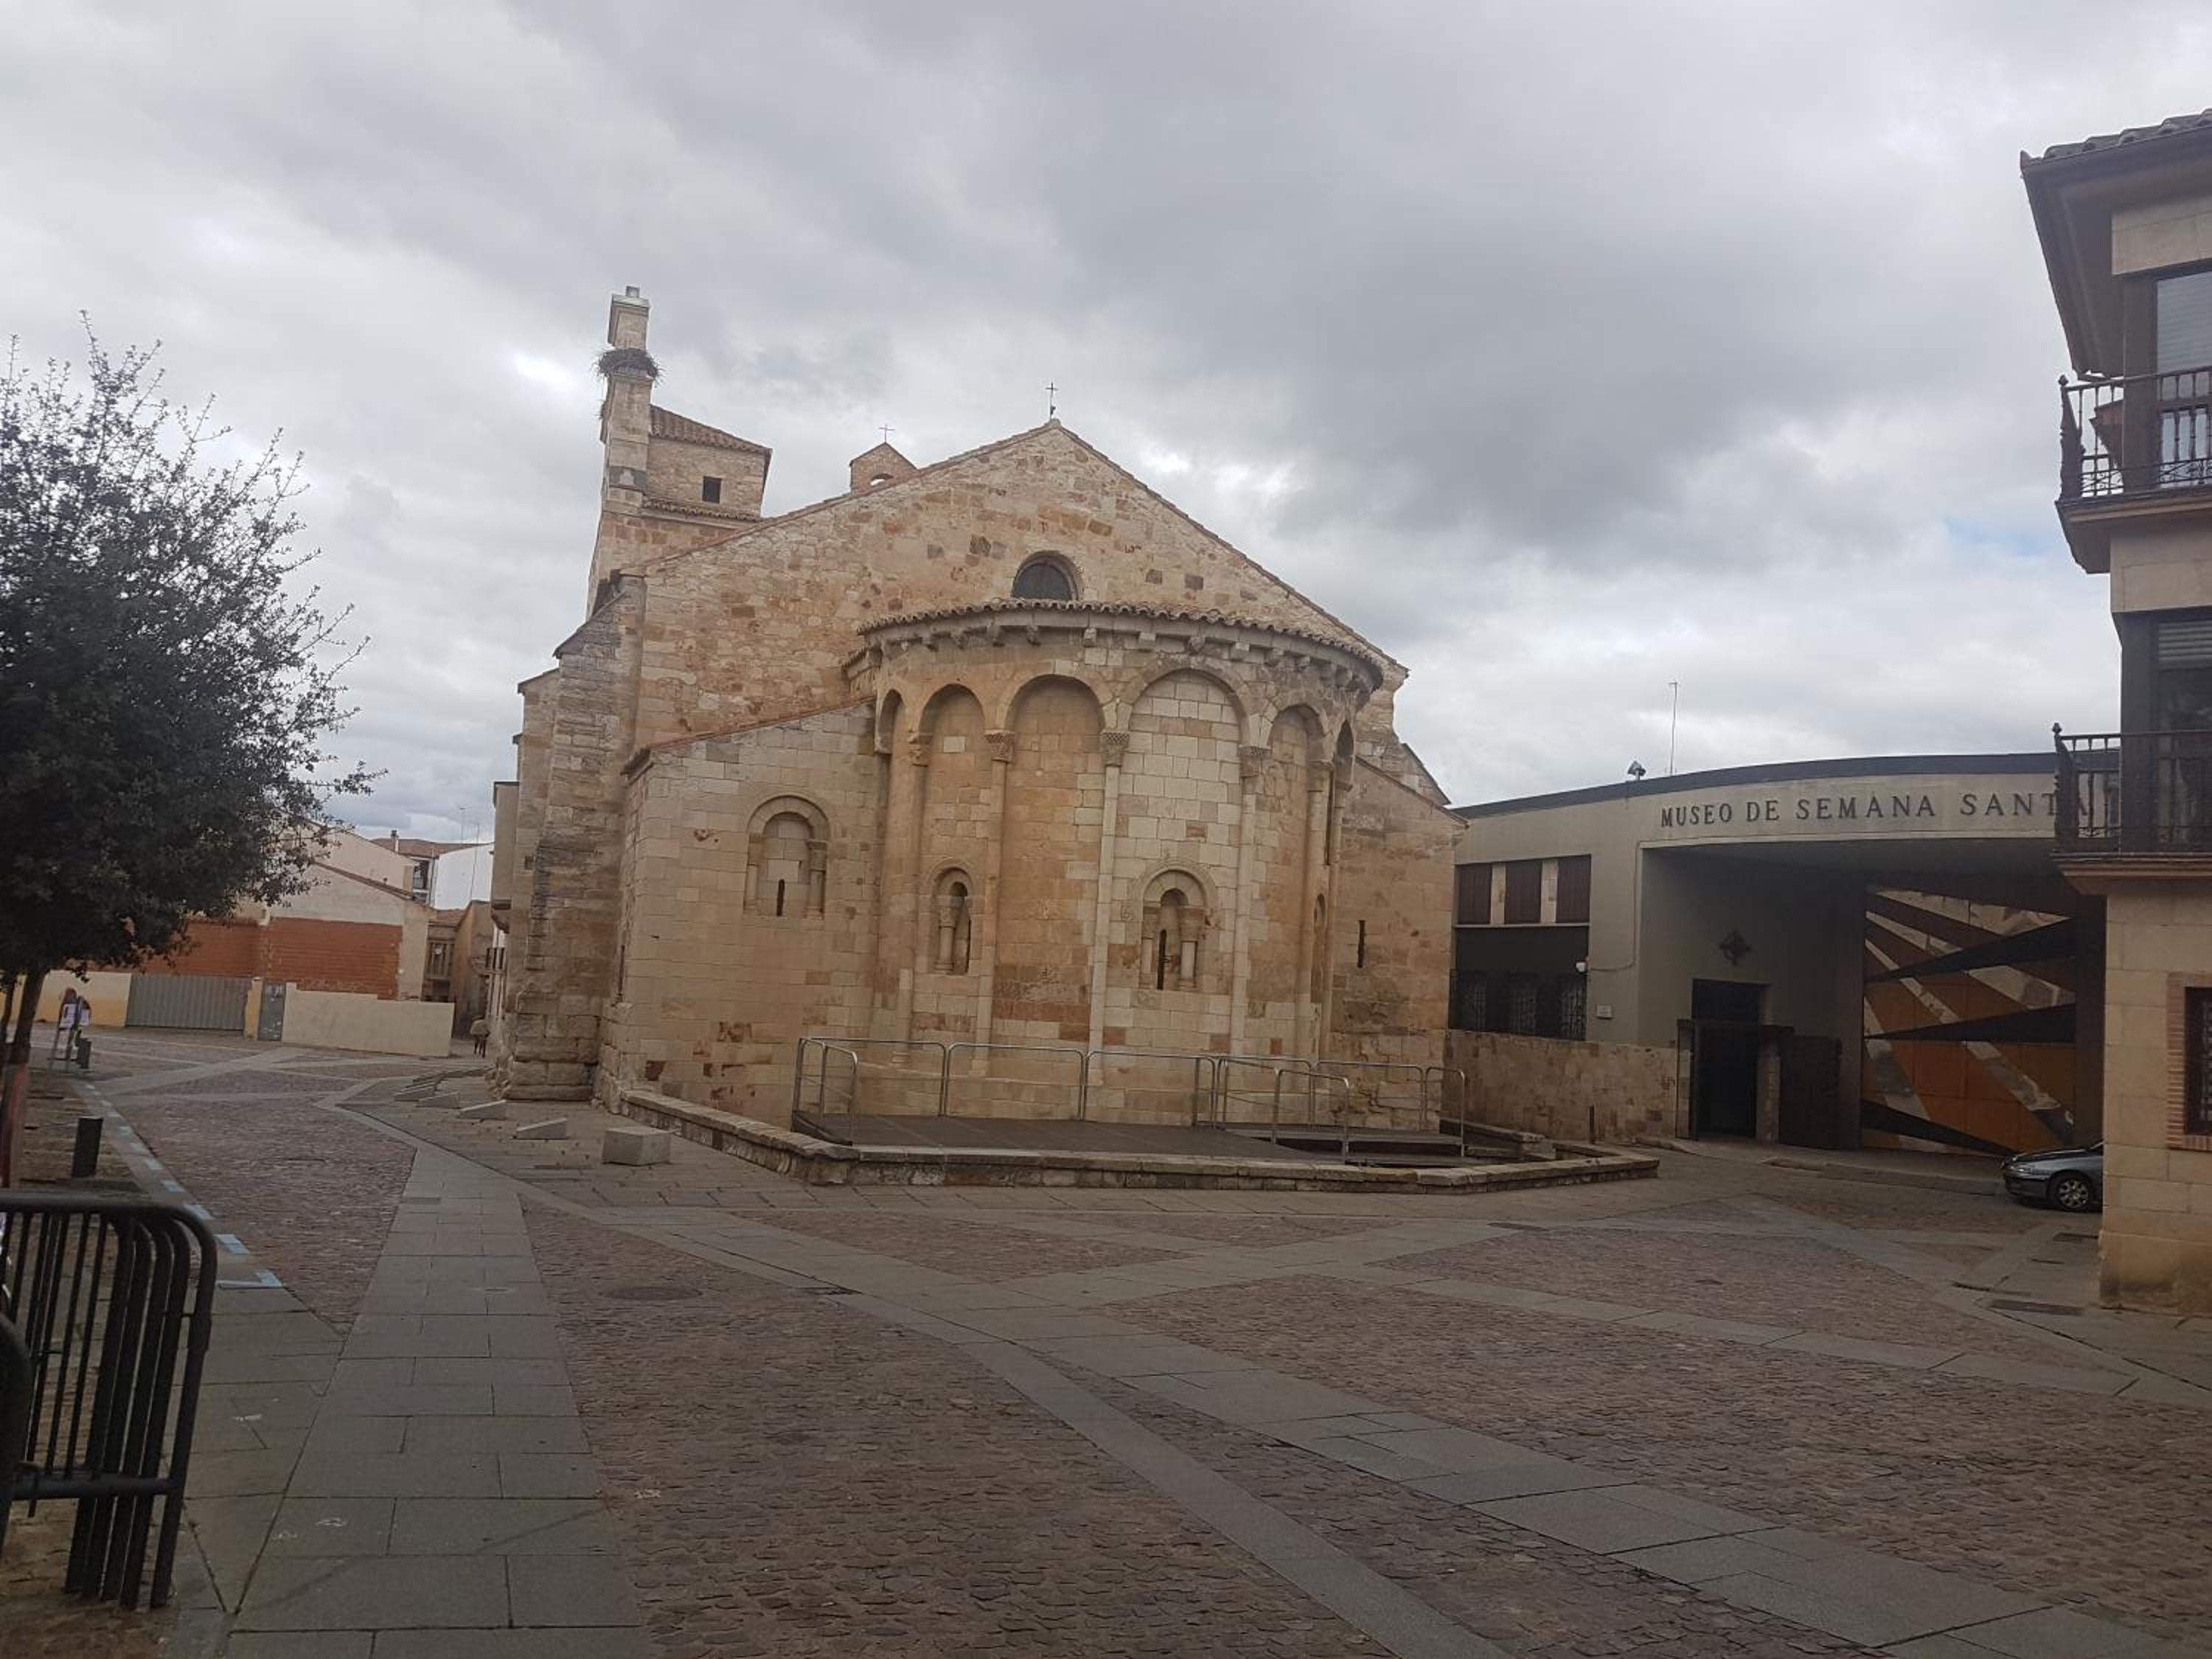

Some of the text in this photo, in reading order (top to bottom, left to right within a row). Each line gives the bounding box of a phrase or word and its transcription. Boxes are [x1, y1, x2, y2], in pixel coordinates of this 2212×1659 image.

[1661, 803, 1732, 827] MUSEO
[1746, 800, 1780, 822] DE
[1795, 794, 1935, 820] SEMANA
